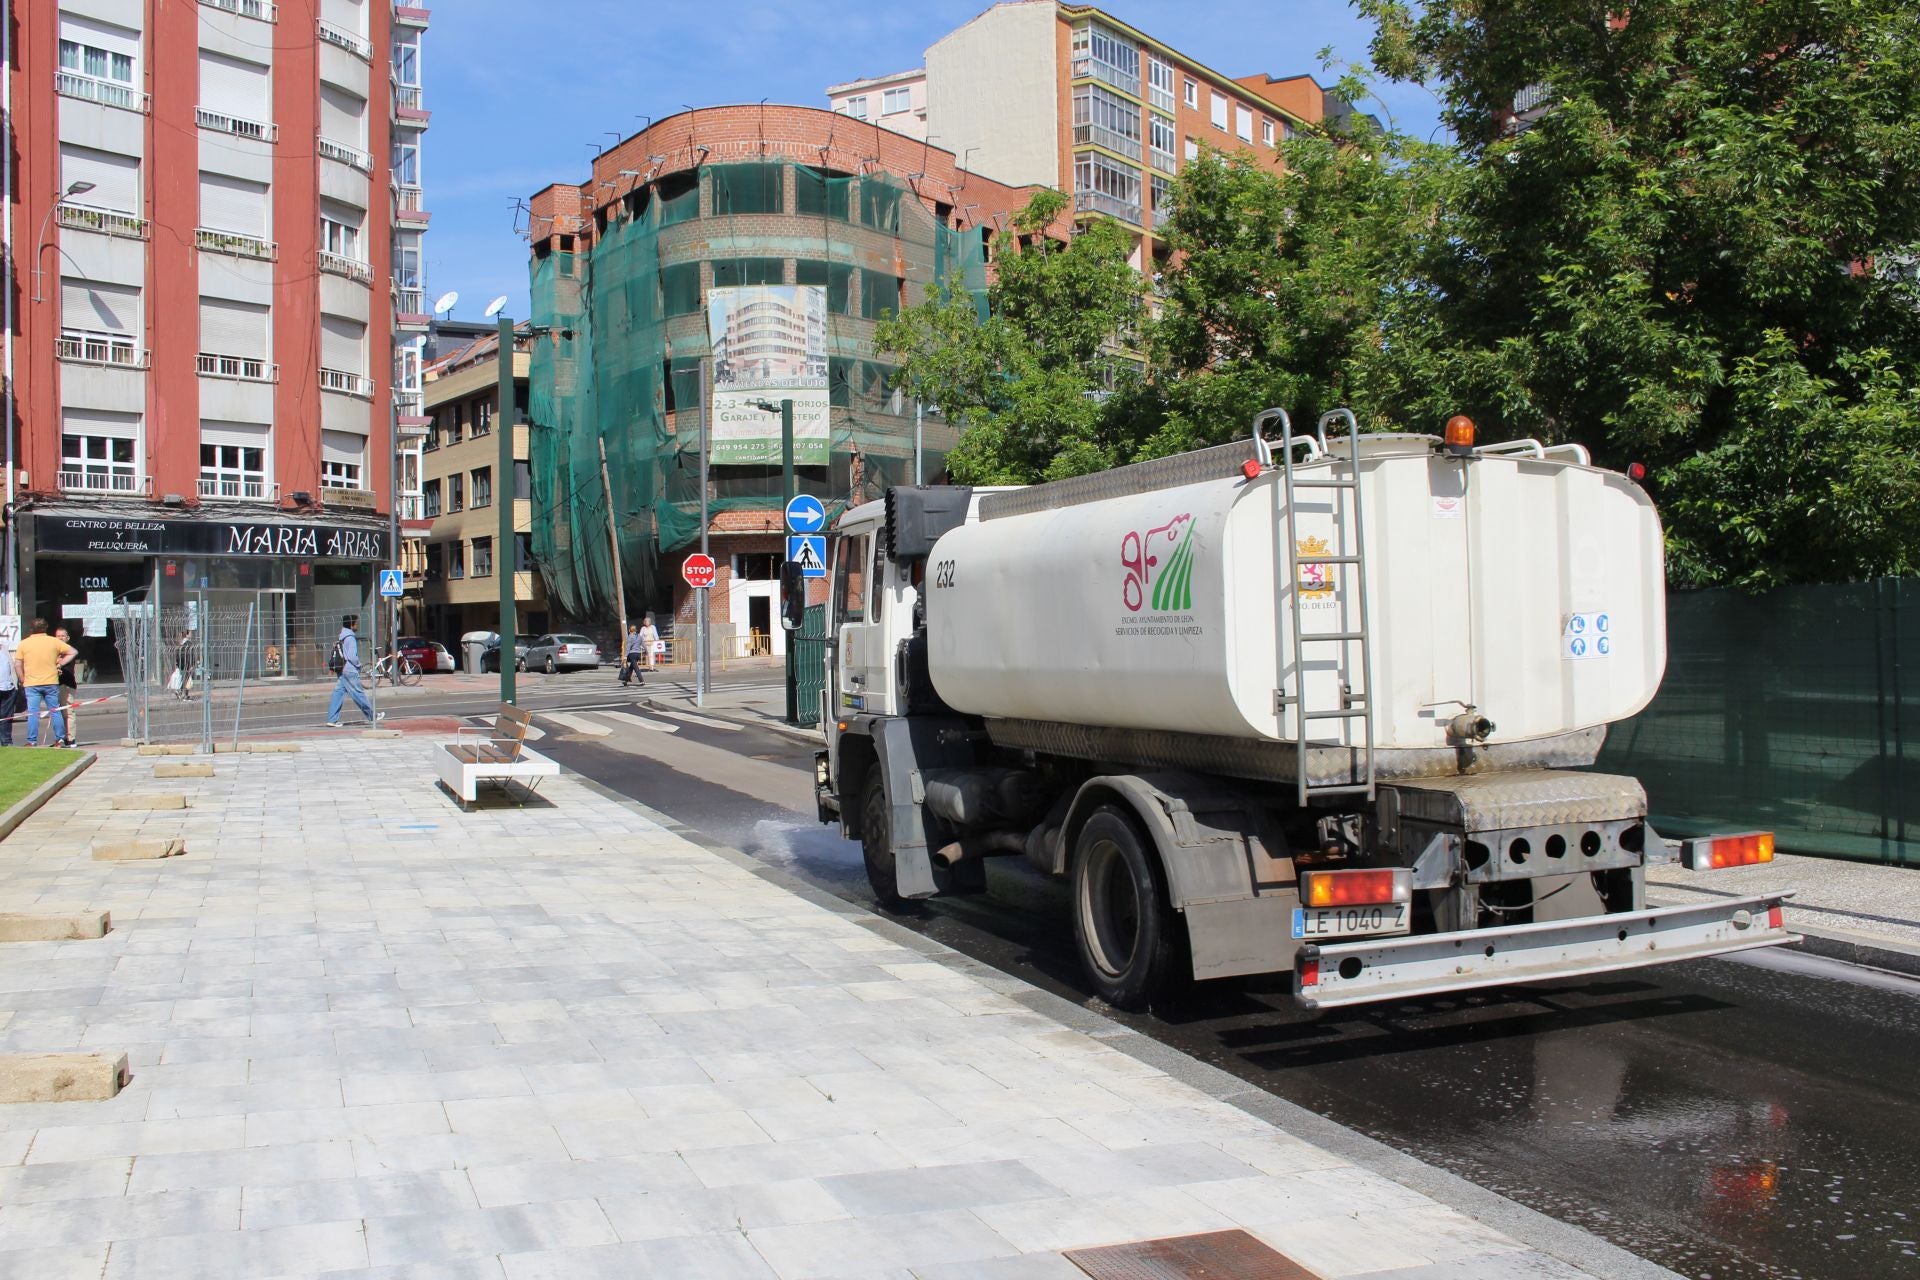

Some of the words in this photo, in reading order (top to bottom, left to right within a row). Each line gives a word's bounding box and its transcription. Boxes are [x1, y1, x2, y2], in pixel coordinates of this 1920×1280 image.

[781, 379, 794, 387] DE
[798, 377, 826, 387] LUJO
[66, 521, 107, 529] CENTRO
[109, 522, 122, 530] DE
[125, 523, 165, 531] BELLEZA
[88, 541, 148, 550] PELUQUERÍA
[226, 526, 319, 555] MARIA
[326, 530, 380, 558] ARIAS
[686, 566, 712, 574] STOP
[937, 560, 954, 588] 232
[1174, 615, 1180, 623] DE
[1115, 627, 1139, 636] SERVICIOS
[1140, 627, 1147, 635] DE
[1147, 626, 1174, 635] RECOGIDA
[1179, 626, 1203, 635] LIMPIEZA
[1336, 908, 1382, 932] 1040
[1395, 906, 1405, 927] Z
